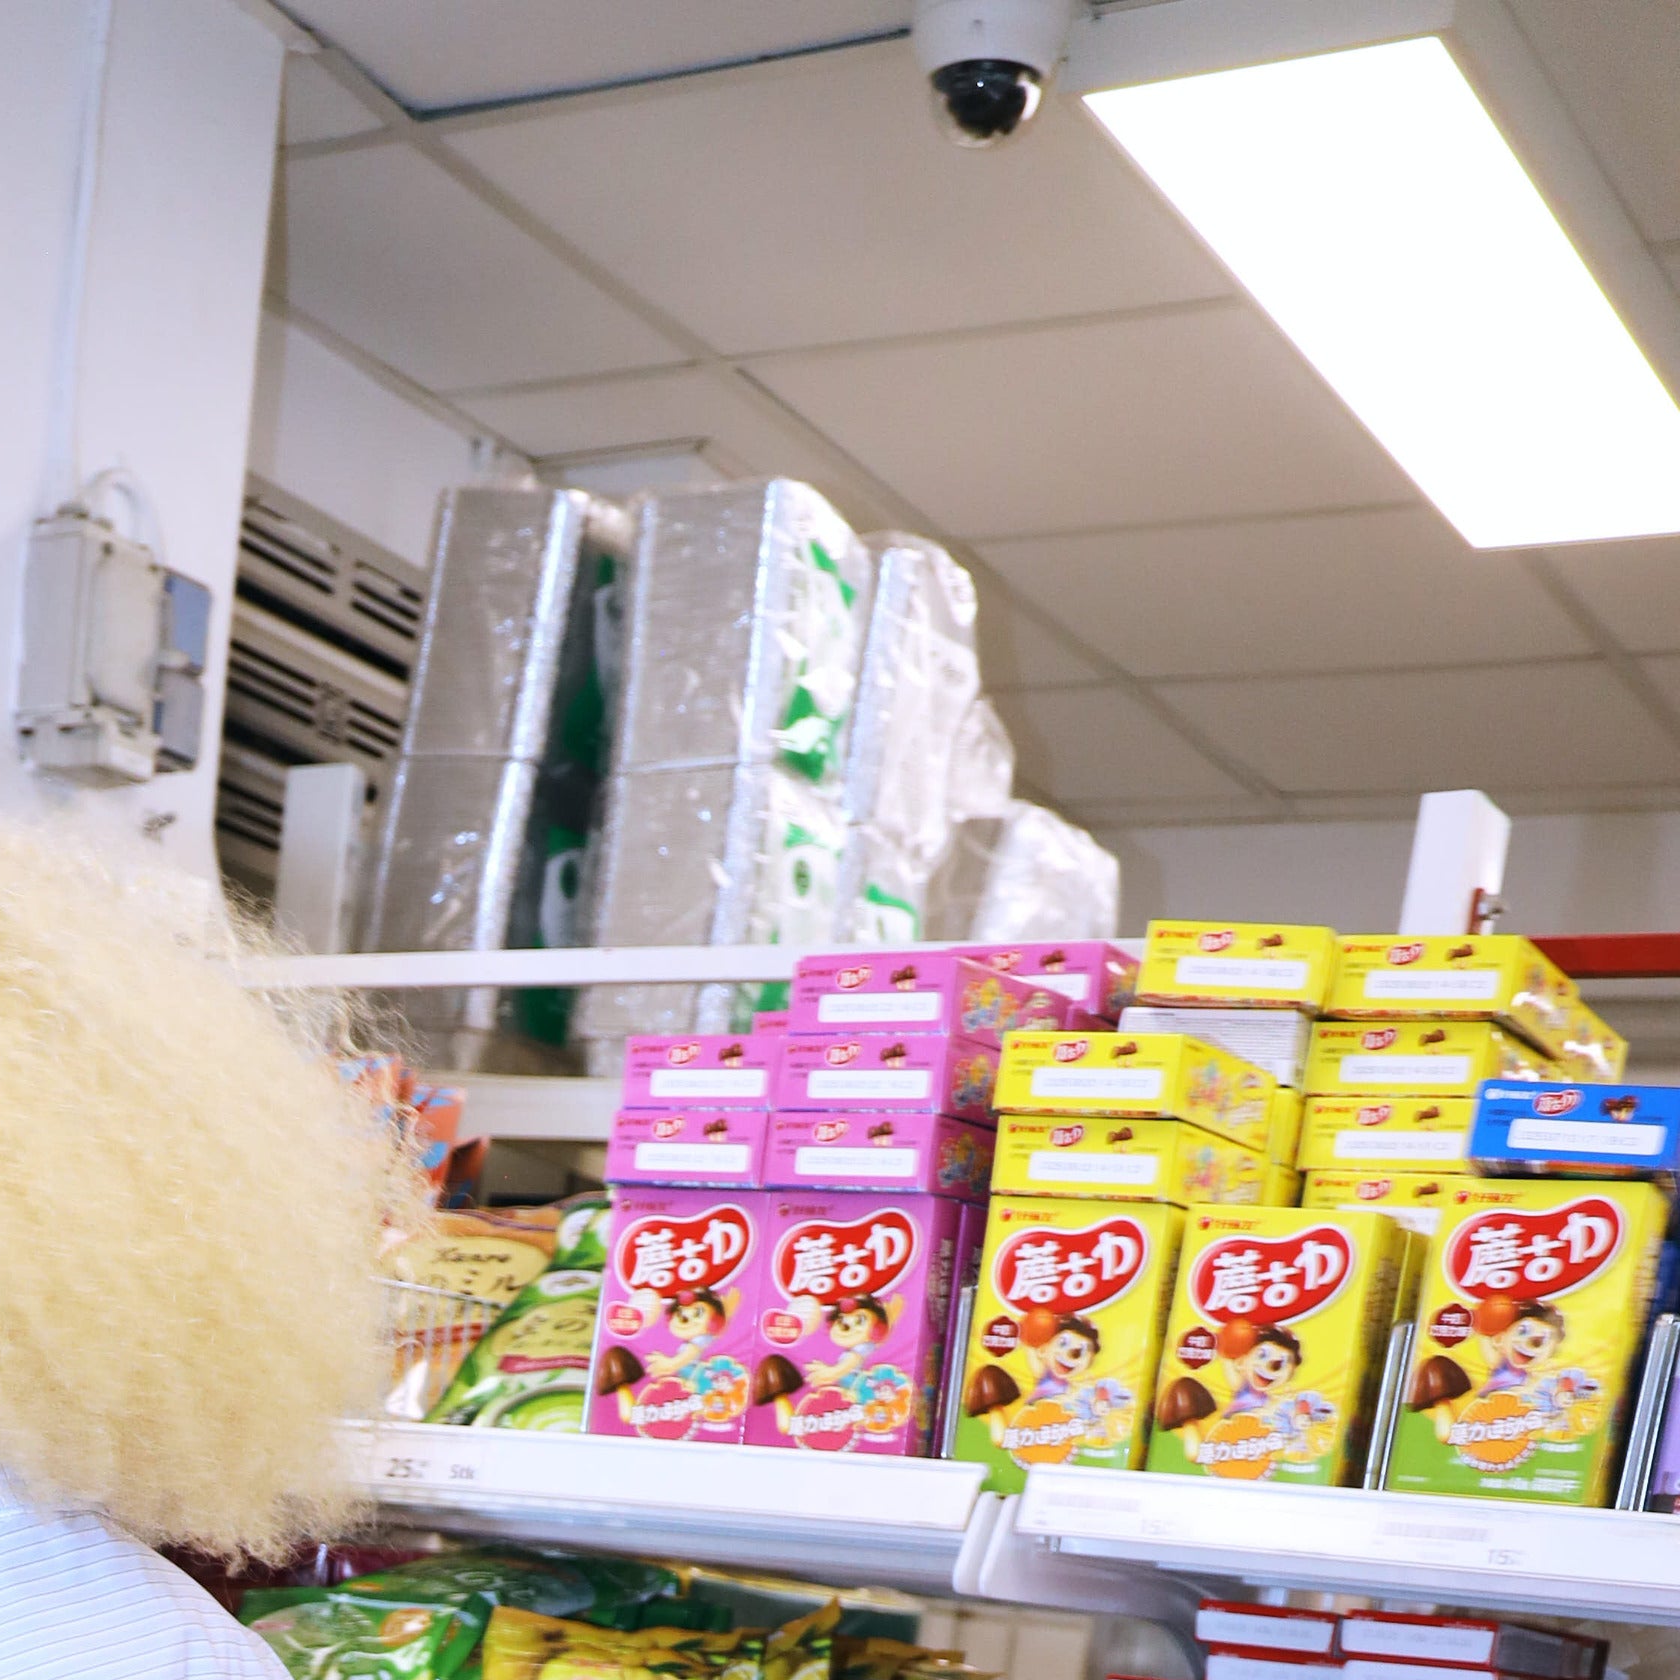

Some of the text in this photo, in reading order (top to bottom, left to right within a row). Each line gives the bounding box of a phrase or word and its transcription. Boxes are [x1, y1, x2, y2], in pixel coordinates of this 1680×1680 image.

[631, 1220, 741, 1287] 蘑古力
[791, 1224, 908, 1293] 蘑古力
[1007, 1232, 1136, 1302] 蘑古力
[1207, 1241, 1341, 1312] 蘑古力
[1460, 1212, 1608, 1290] 蘑古力
